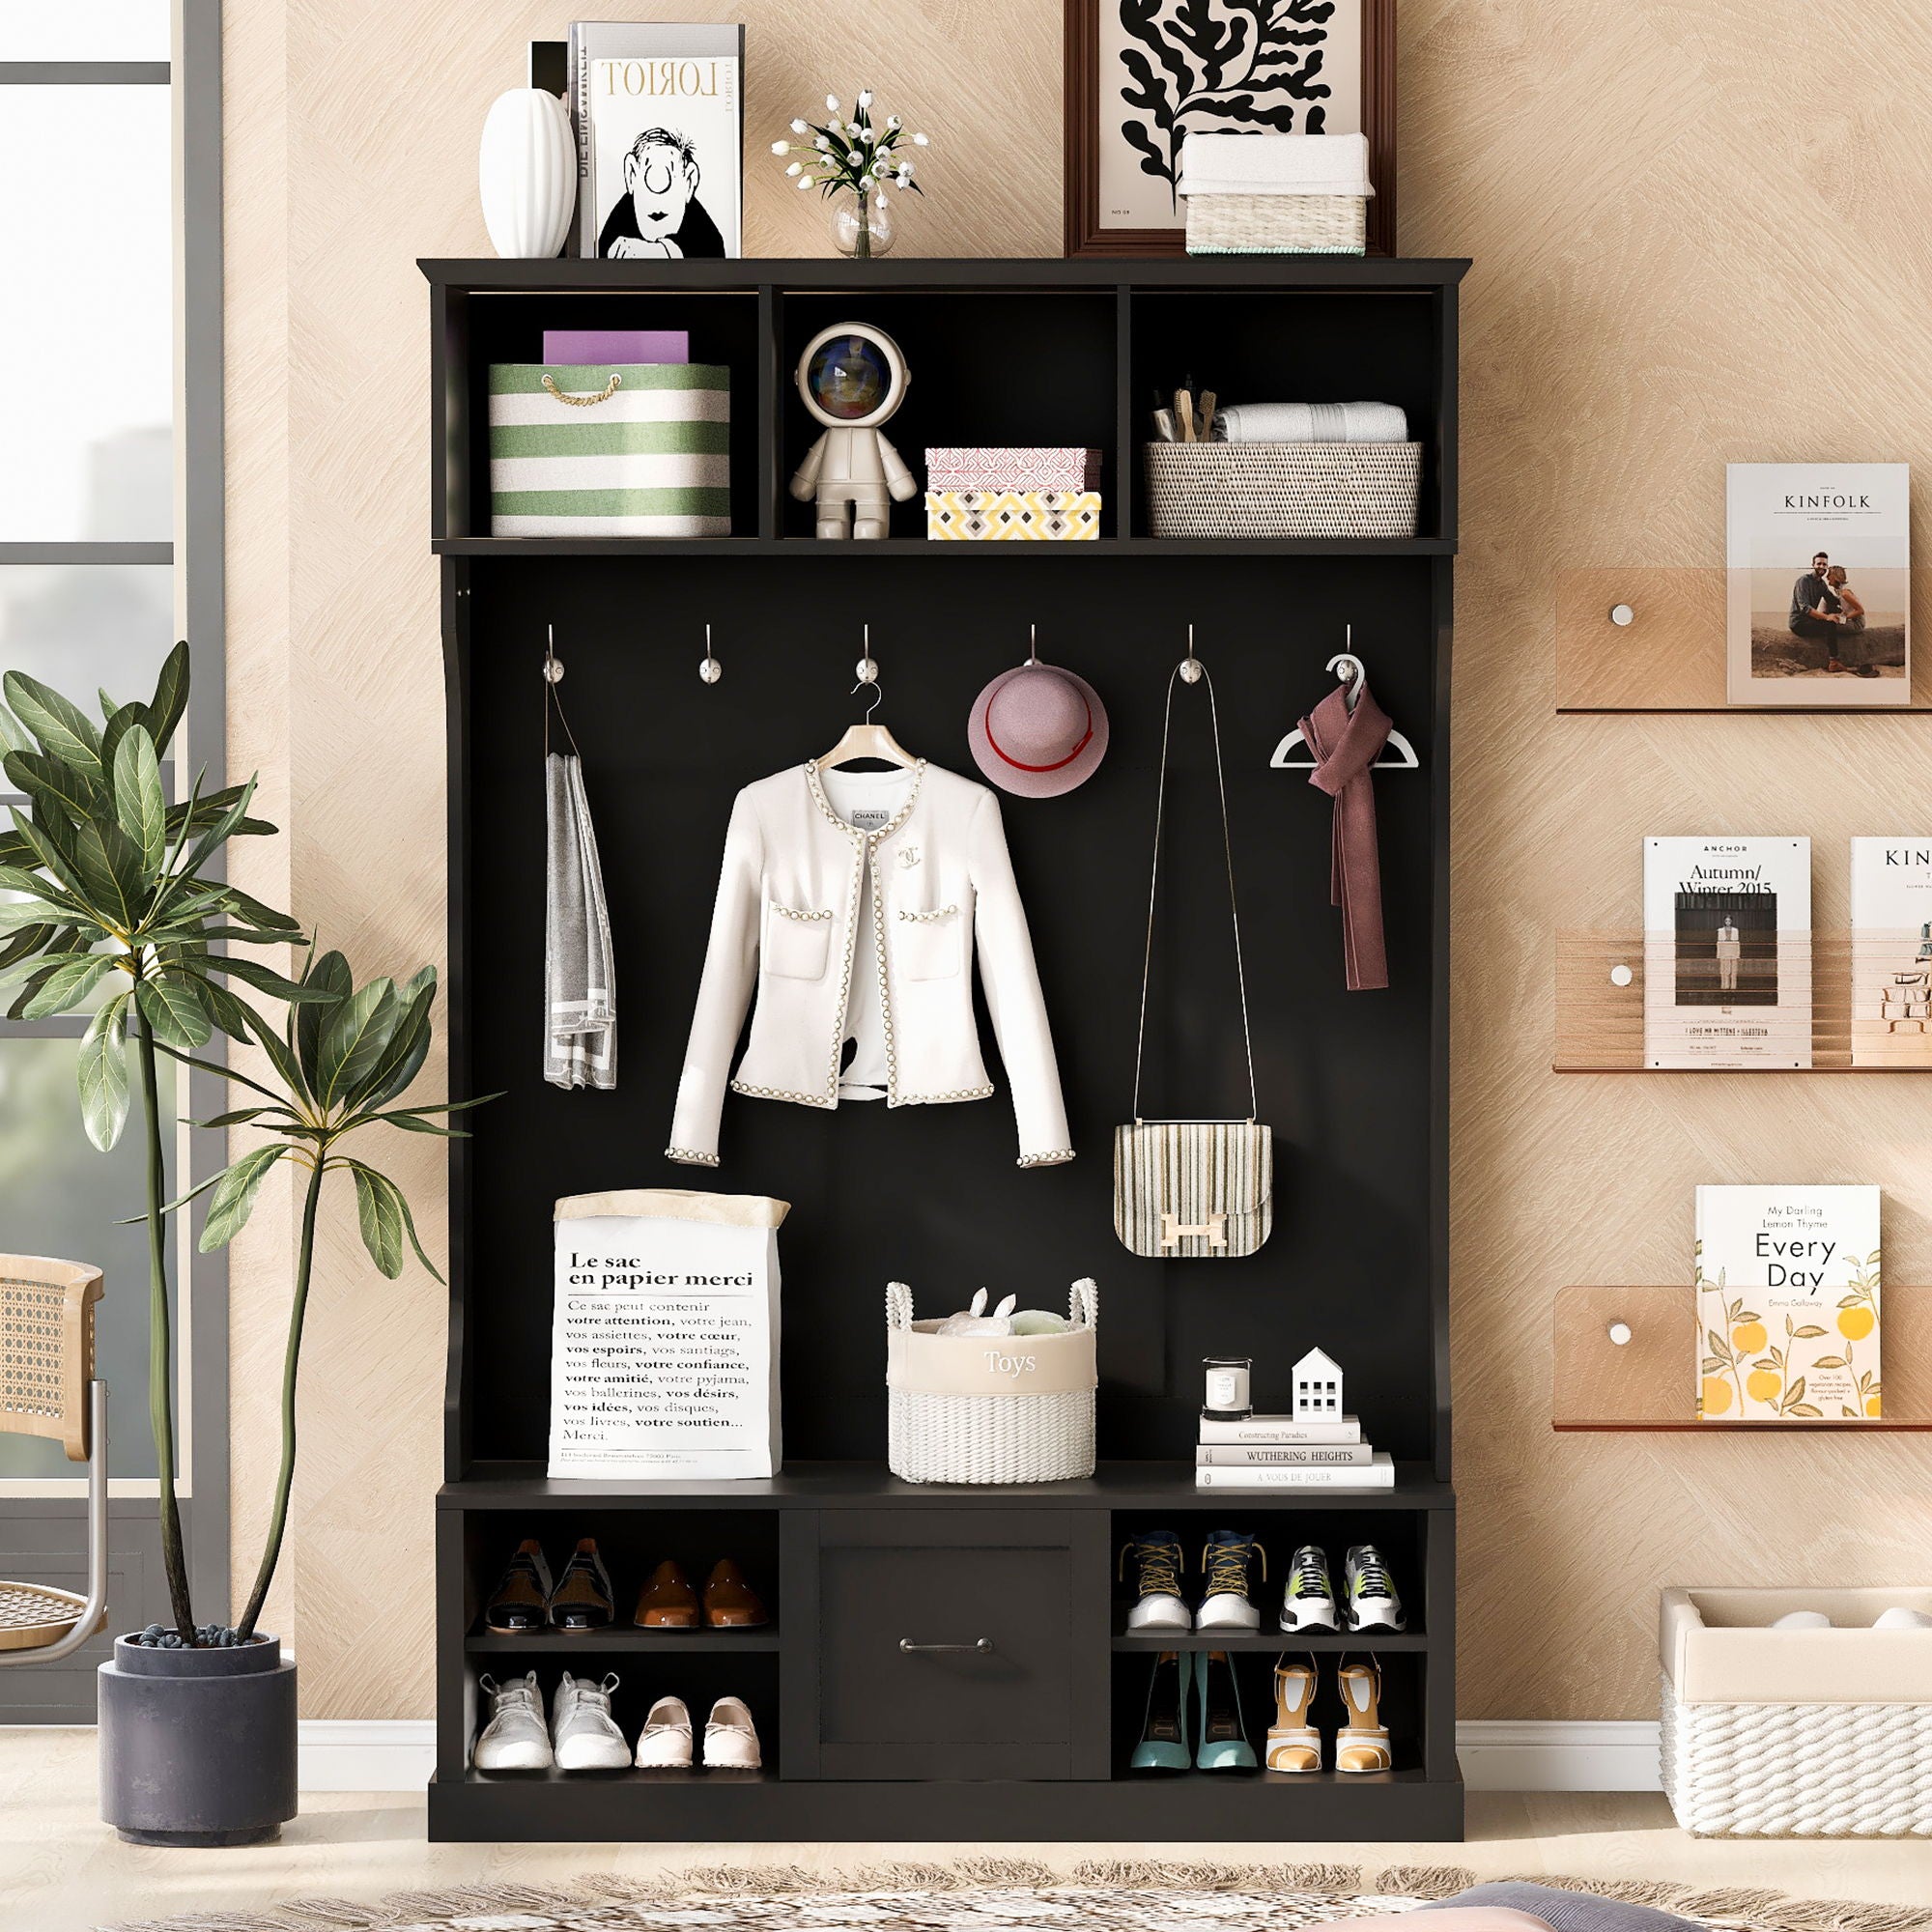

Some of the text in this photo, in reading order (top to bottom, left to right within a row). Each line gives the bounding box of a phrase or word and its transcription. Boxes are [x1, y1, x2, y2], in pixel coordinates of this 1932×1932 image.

[1784, 496, 1871, 509] KINFOLK
[1690, 865, 1762, 881] Autumn/
[1679, 881, 1772, 895] Winter 2015
[1768, 1206, 1823, 1217] My Darling
[1762, 1218, 1829, 1231] Lemon Thyme
[1756, 1233, 1836, 1265] Every
[570, 1252, 641, 1268] Le sac
[569, 1270, 753, 1290] en papier merci
[1768, 1264, 1825, 1295] Day
[568, 1301, 587, 1312] Ce
[615, 1303, 644, 1314] peut
[649, 1302, 710, 1312] contenir
[605, 1317, 675, 1327] attention,
[680, 1318, 716, 1326] votre
[719, 1317, 752, 1329] jean,
[592, 1331, 652, 1342] assiettes,
[657, 1332, 696, 1341] votre
[592, 1346, 647, 1358] espoirs,
[592, 1358, 631, 1371] fleurs,
[677, 1359, 750, 1372] confiance,
[983, 1350, 1037, 1378] Toys
[566, 1374, 750, 1387] votre amitié, votre pyjama,
[564, 1387, 739, 1401] vos ballerines, vos désirs,
[564, 1404, 588, 1412] vos
[592, 1402, 633, 1414] idées,
[665, 1403, 720, 1415] disques,
[564, 1416, 743, 1428] vos livres, votre soutien...
[563, 1430, 609, 1441] Merci.
[1247, 1451, 1353, 1462] WUTHERING HEIGHTS
[1266, 1472, 1289, 1482] VOUS
[1291, 1472, 1302, 1482] DE
